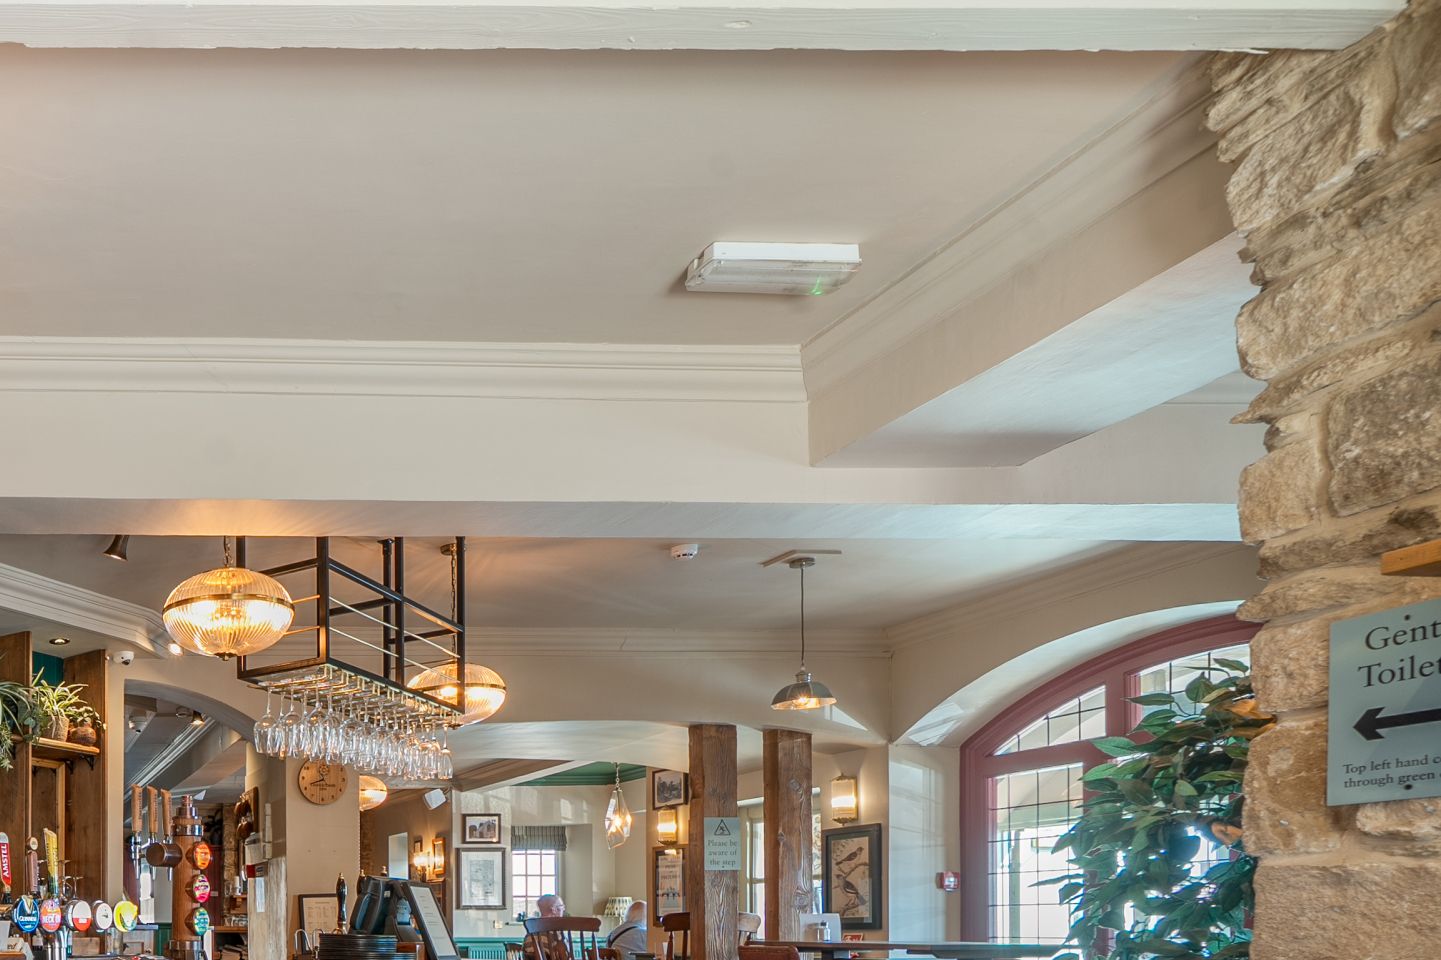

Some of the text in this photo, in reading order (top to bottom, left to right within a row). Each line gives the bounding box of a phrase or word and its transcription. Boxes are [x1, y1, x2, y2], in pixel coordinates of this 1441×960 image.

[1343, 763, 1366, 775] Top
[1370, 760, 1391, 771] left
[1395, 754, 1428, 768] hand
[1344, 773, 1394, 788] through
[1398, 772, 1435, 785] green
[722, 860, 736, 868] step
